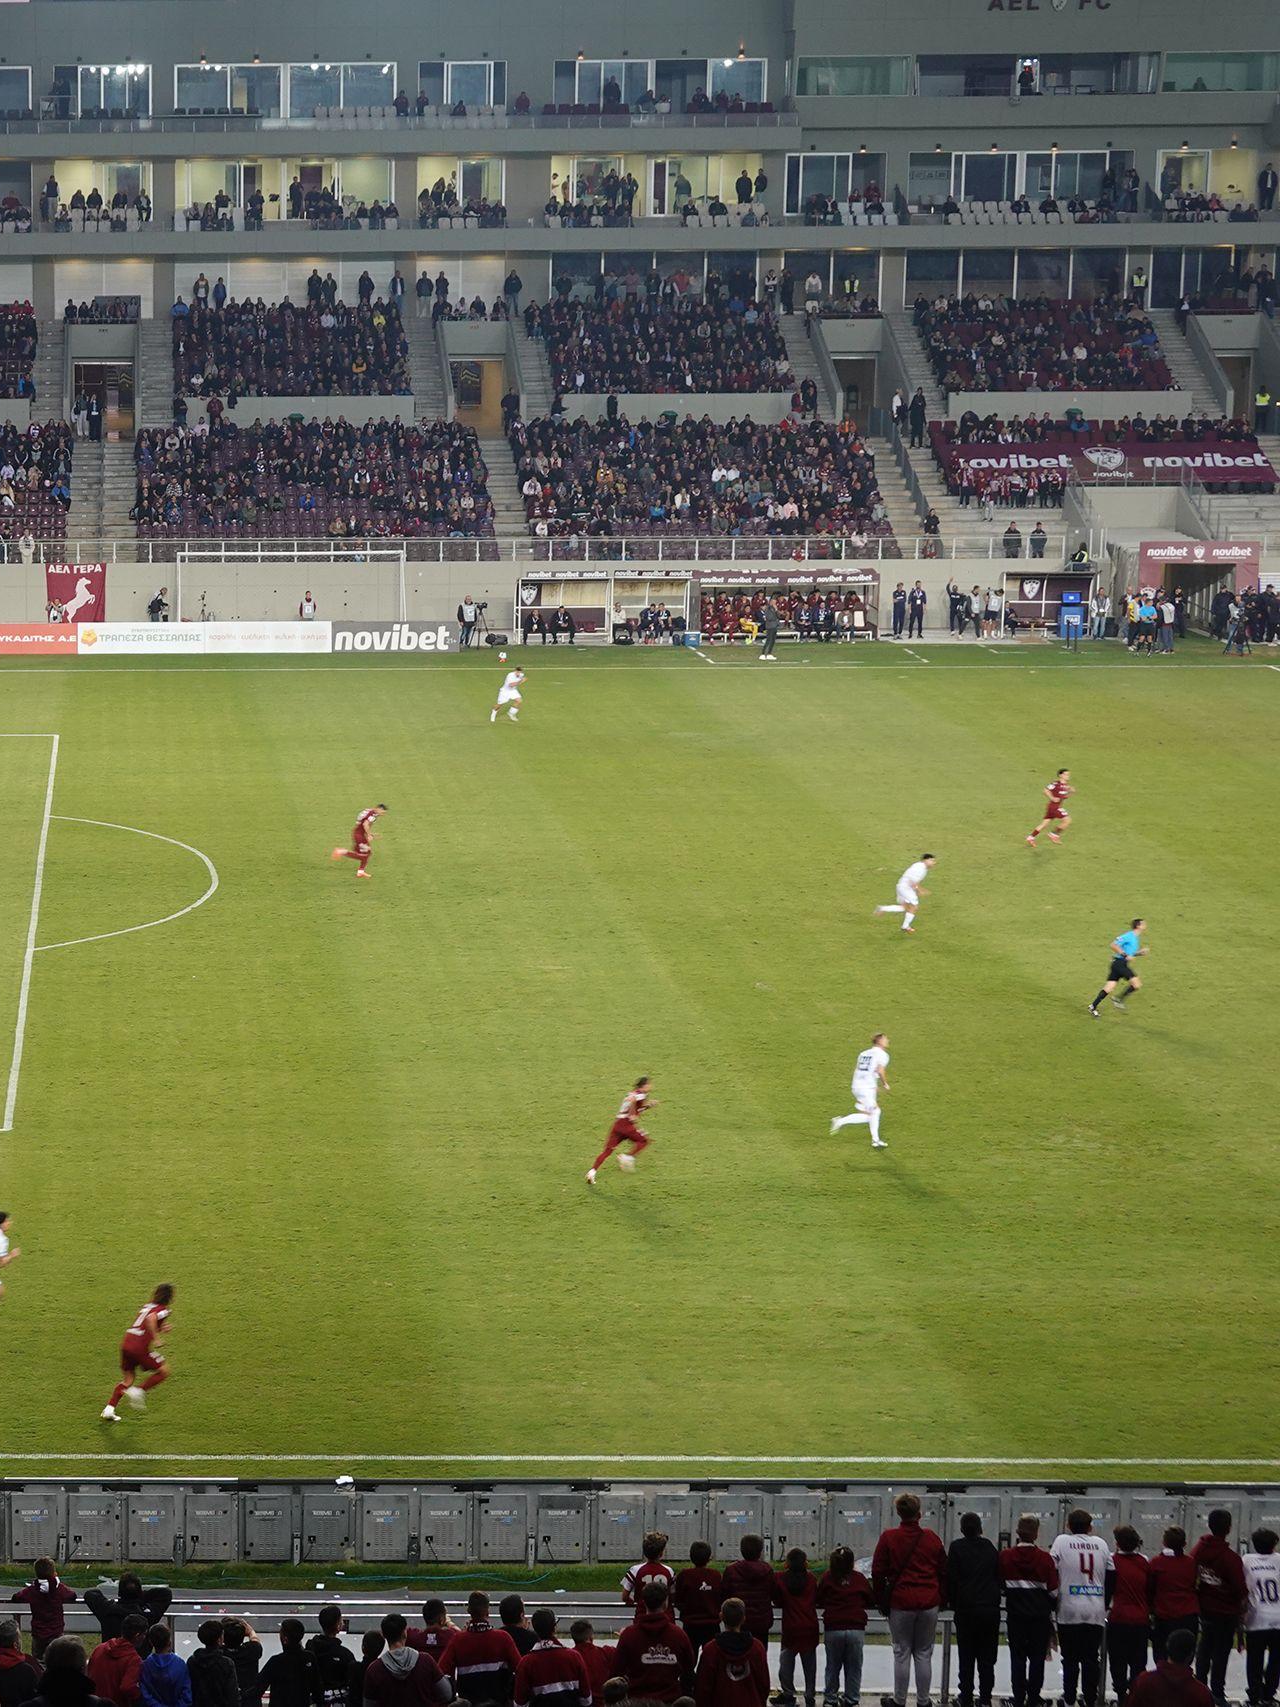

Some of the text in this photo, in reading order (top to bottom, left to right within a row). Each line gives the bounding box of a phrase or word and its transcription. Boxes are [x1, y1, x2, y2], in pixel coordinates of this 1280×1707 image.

[959, 454, 1074, 469] ovibet
[1143, 452, 1270, 468] novibet
[1147, 546, 1189, 556] novibet
[1212, 546, 1253, 556] novibet
[48, 564, 102, 574] ΑΕΛ ΓΕΡΑ
[817, 575, 843, 583] novibet
[846, 574, 873, 582] novibet
[334, 624, 450, 651] novibet
[1079, 1553, 1094, 1581] 4
[1257, 1579, 1280, 1602] 10
